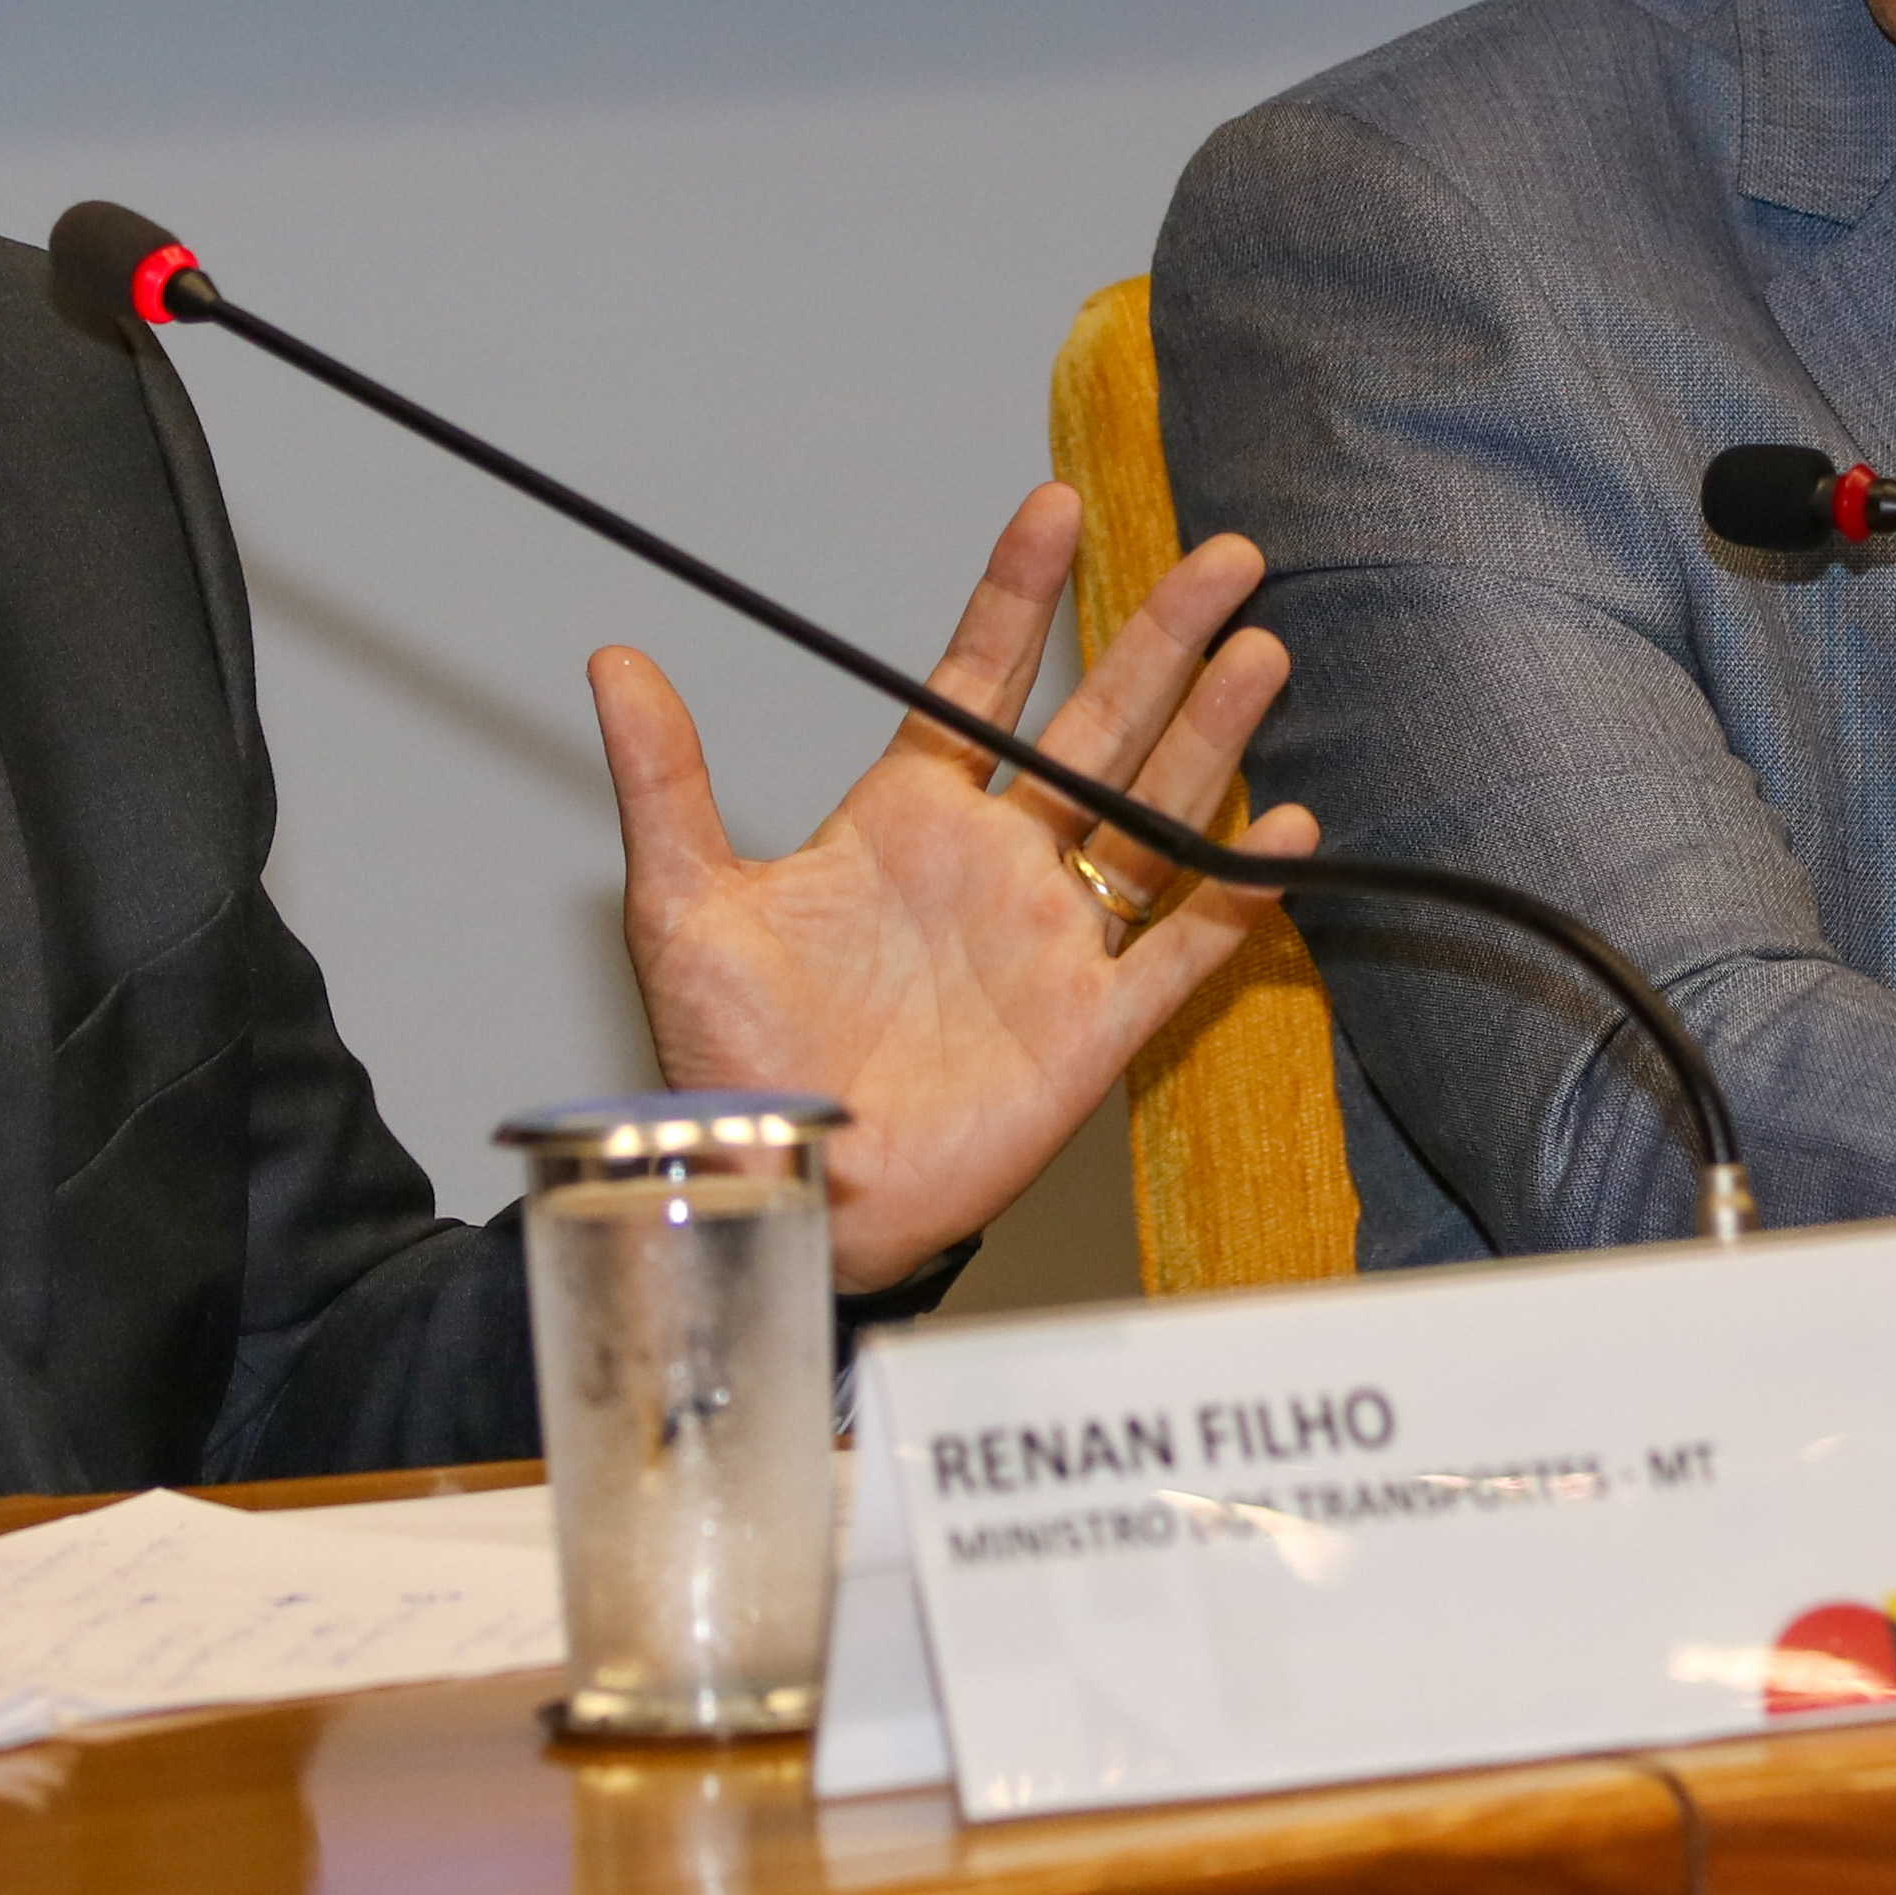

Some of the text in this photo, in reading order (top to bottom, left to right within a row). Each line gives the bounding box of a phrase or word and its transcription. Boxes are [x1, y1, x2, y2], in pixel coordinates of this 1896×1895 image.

[930, 1386, 1396, 1498] RENAN FILHO
[947, 1504, 1178, 1566] MINISTRO
[1646, 1440, 1716, 1488] MT
